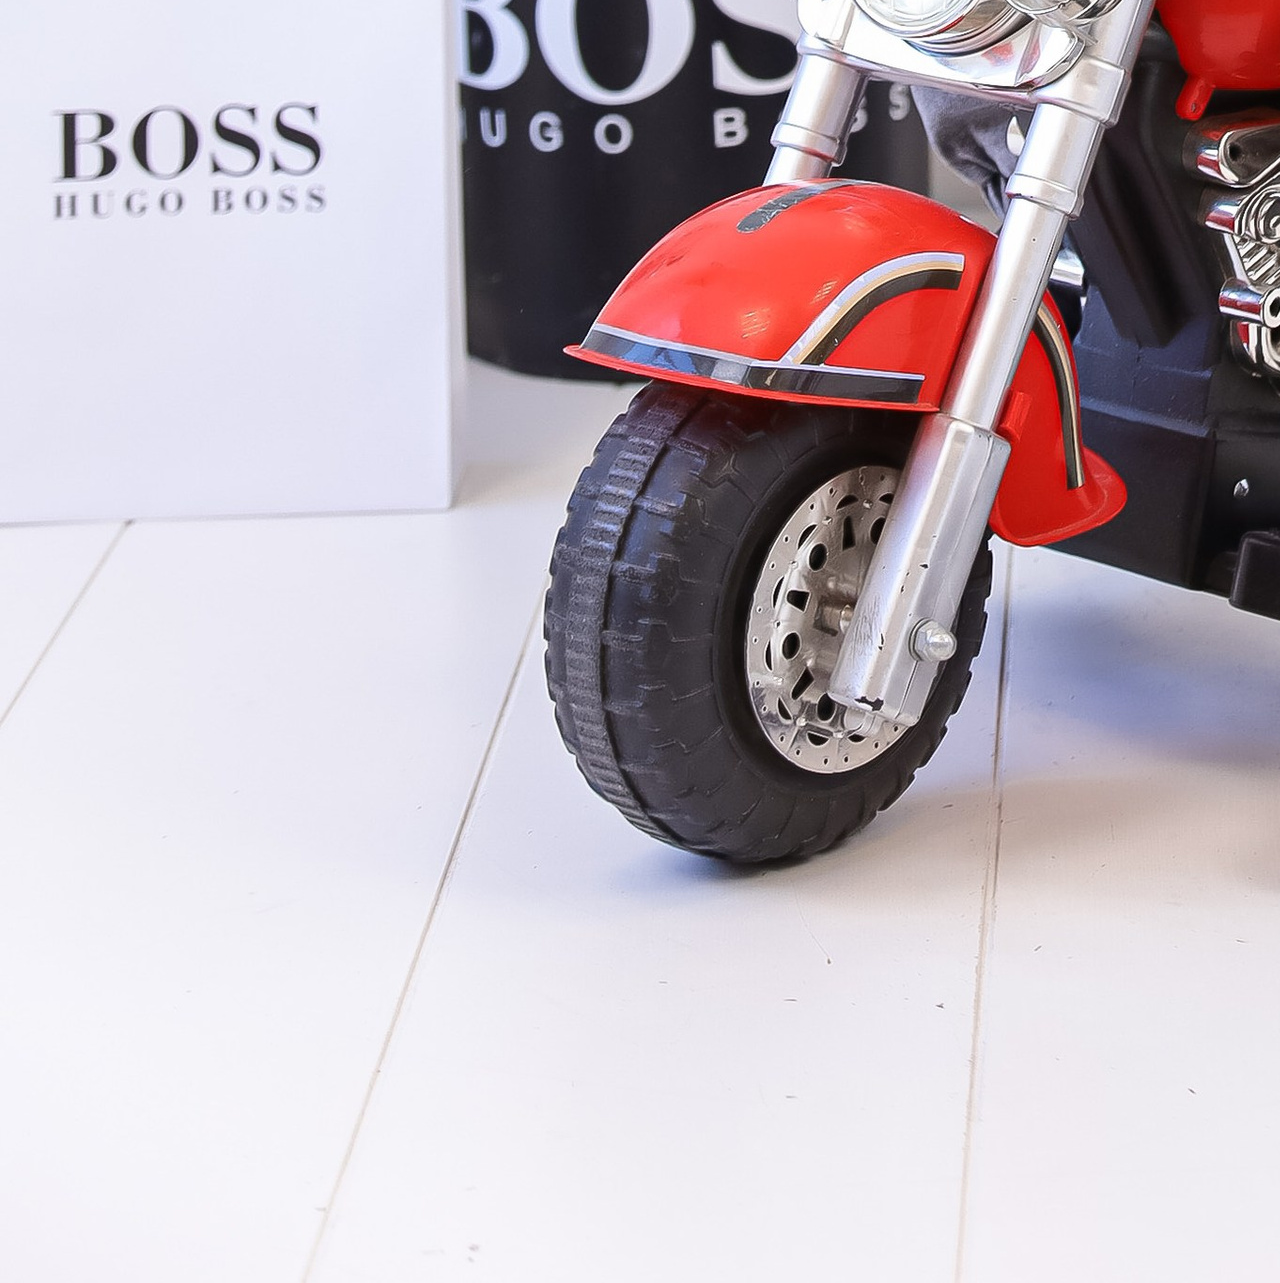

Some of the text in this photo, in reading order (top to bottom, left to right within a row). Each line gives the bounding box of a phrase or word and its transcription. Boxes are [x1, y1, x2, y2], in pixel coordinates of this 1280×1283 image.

[52, 102, 322, 182] BOSS
[463, 107, 634, 155] UGO
[54, 185, 327, 220] HUGO BOSS
